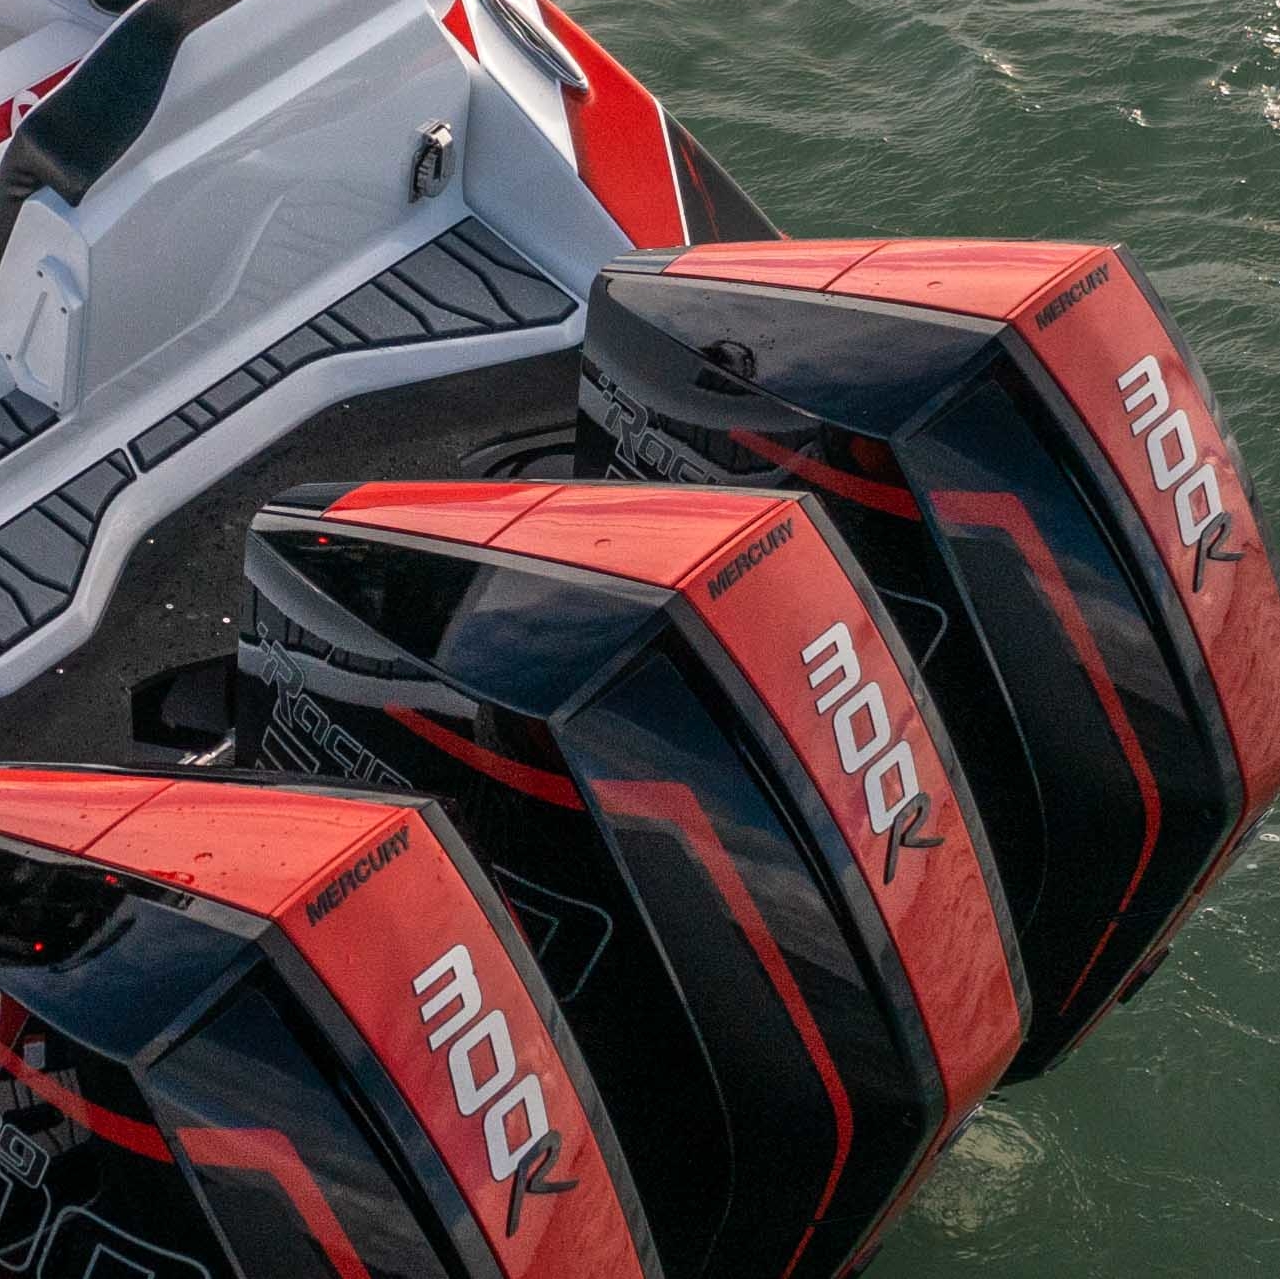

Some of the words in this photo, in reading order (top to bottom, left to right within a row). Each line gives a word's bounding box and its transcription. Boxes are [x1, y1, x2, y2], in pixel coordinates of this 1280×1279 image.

[1034, 263, 1110, 331] MERCURY
[706, 518, 795, 601] MERCURY
[305, 823, 413, 928] MERCURY
